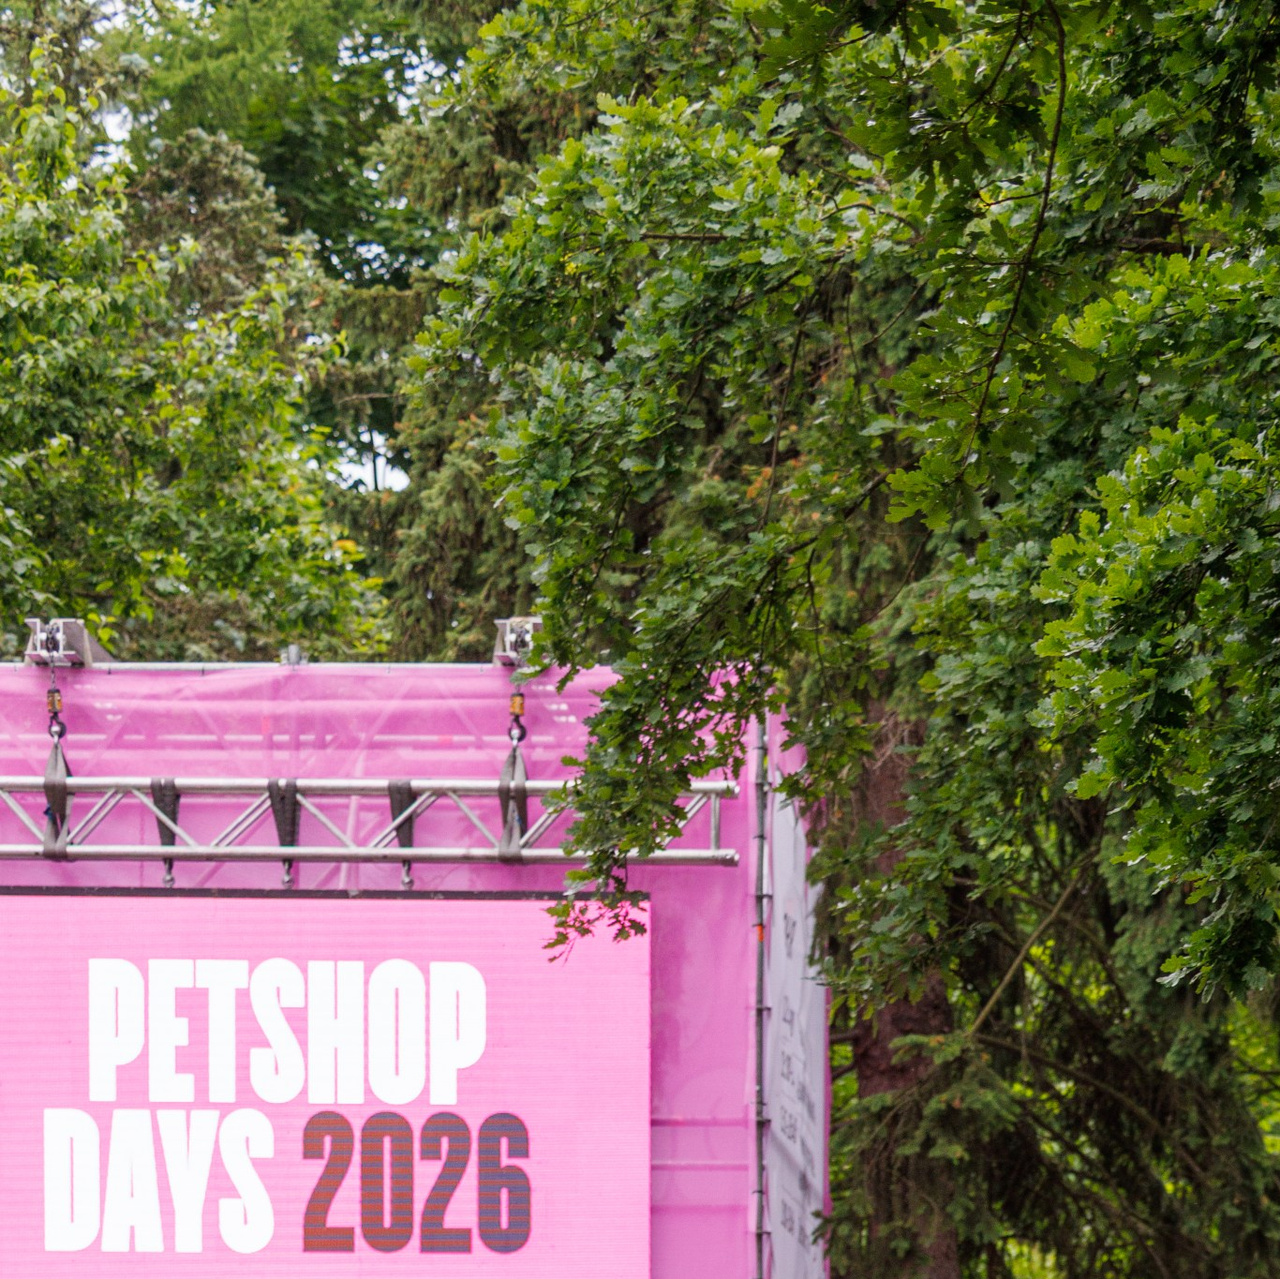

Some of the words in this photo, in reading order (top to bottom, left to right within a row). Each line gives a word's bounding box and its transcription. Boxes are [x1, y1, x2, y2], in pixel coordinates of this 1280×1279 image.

[88, 957, 487, 1105] PETSHOP
[43, 1108, 275, 1253] DAYS
[302, 1110, 532, 1254] 2026
